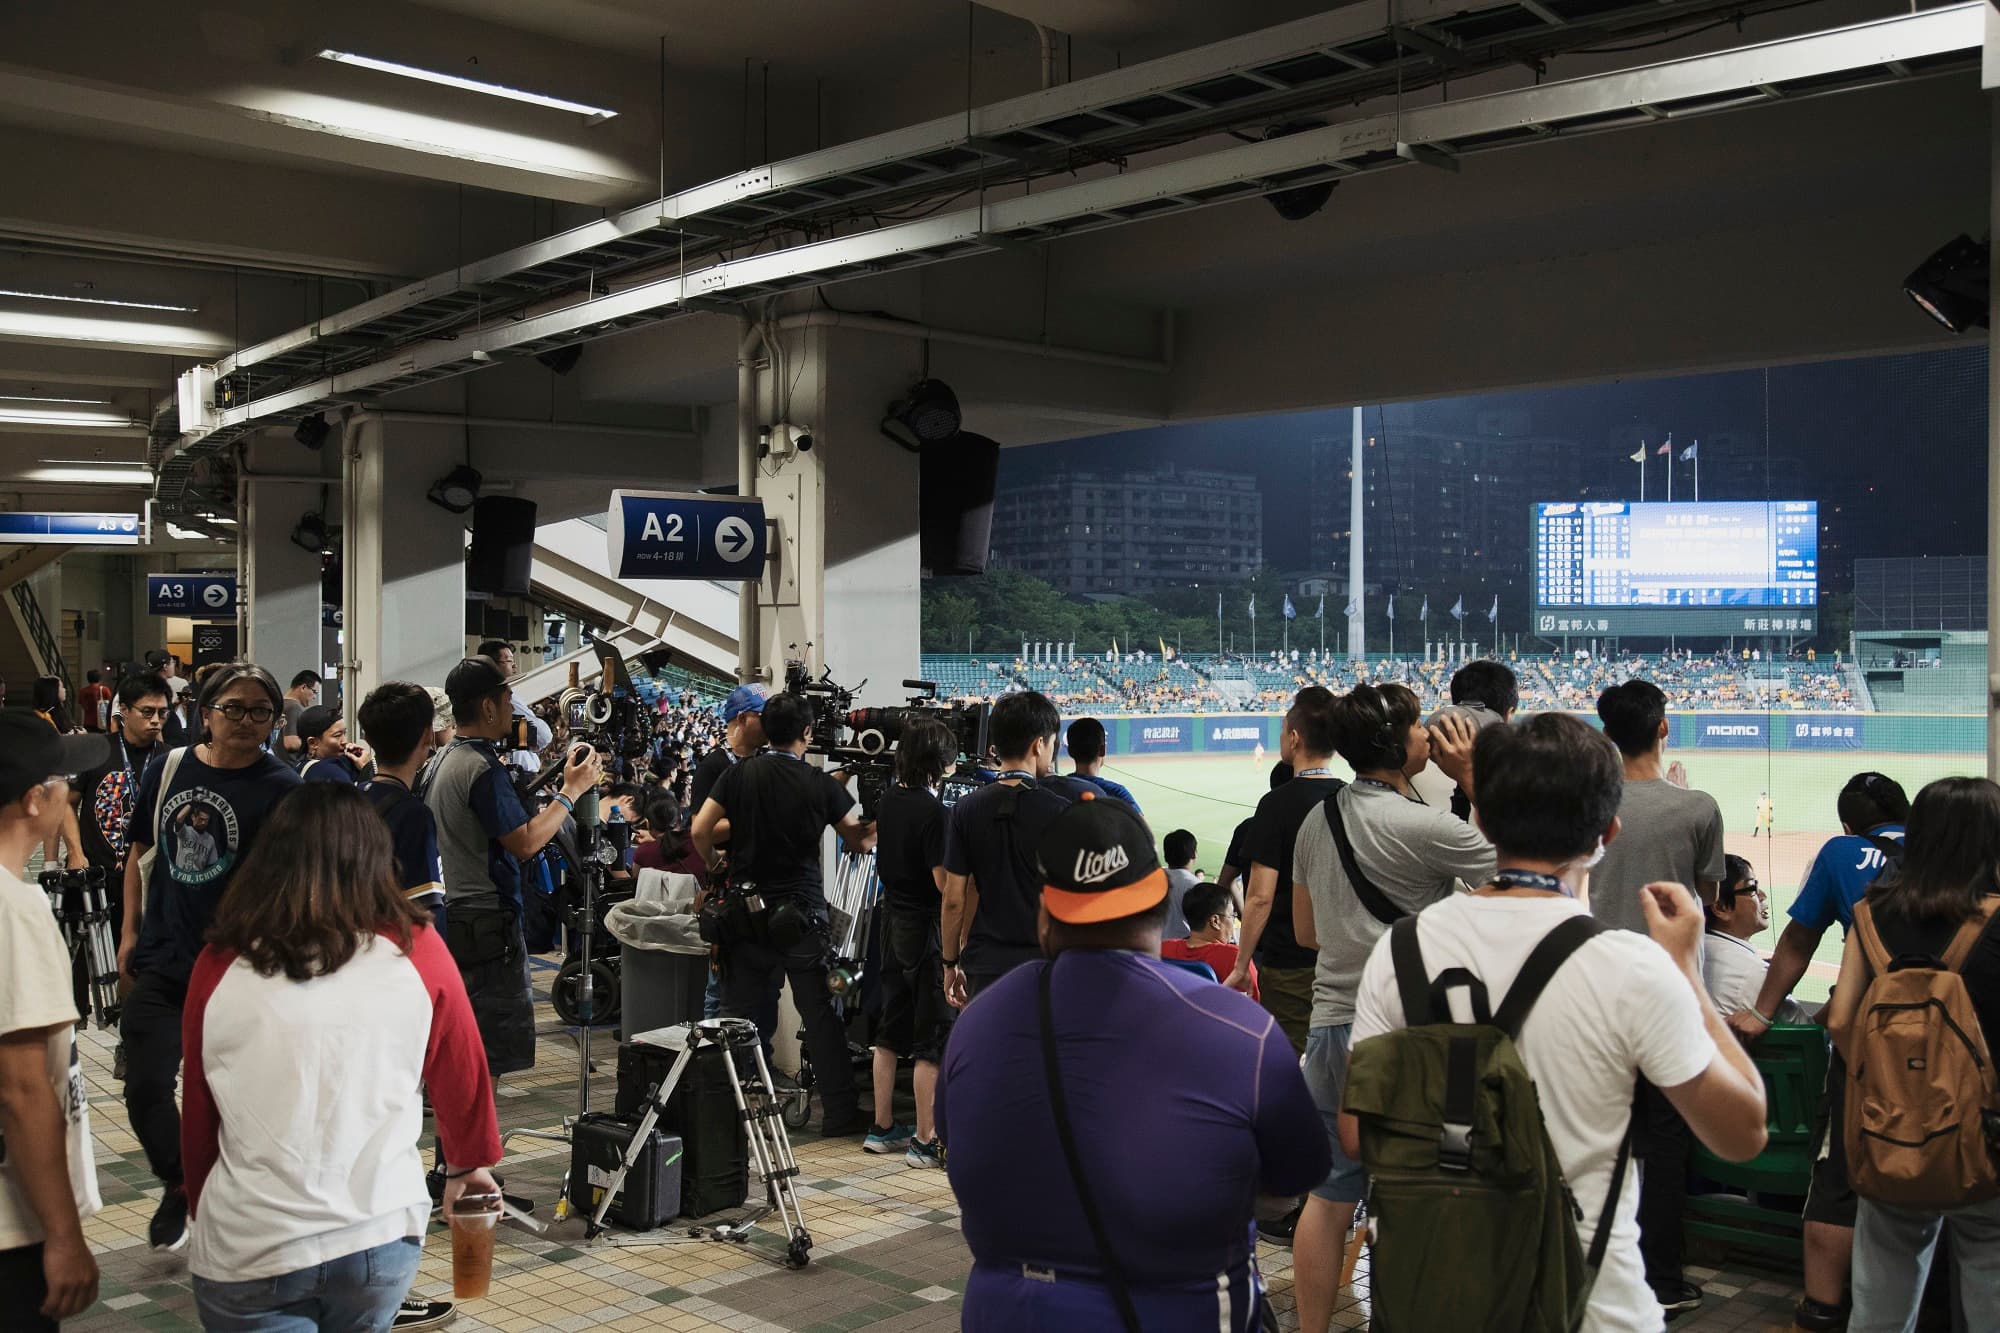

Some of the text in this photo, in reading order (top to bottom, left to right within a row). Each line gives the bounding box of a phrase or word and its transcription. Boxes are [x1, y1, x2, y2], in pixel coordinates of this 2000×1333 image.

[97, 519, 117, 531] A3
[641, 512, 684, 542] A2
[158, 583, 185, 599] A3
[210, 795, 237, 842] MARINERS
[195, 864, 223, 882] ICHIRO
[1073, 844, 1129, 884] Lions
